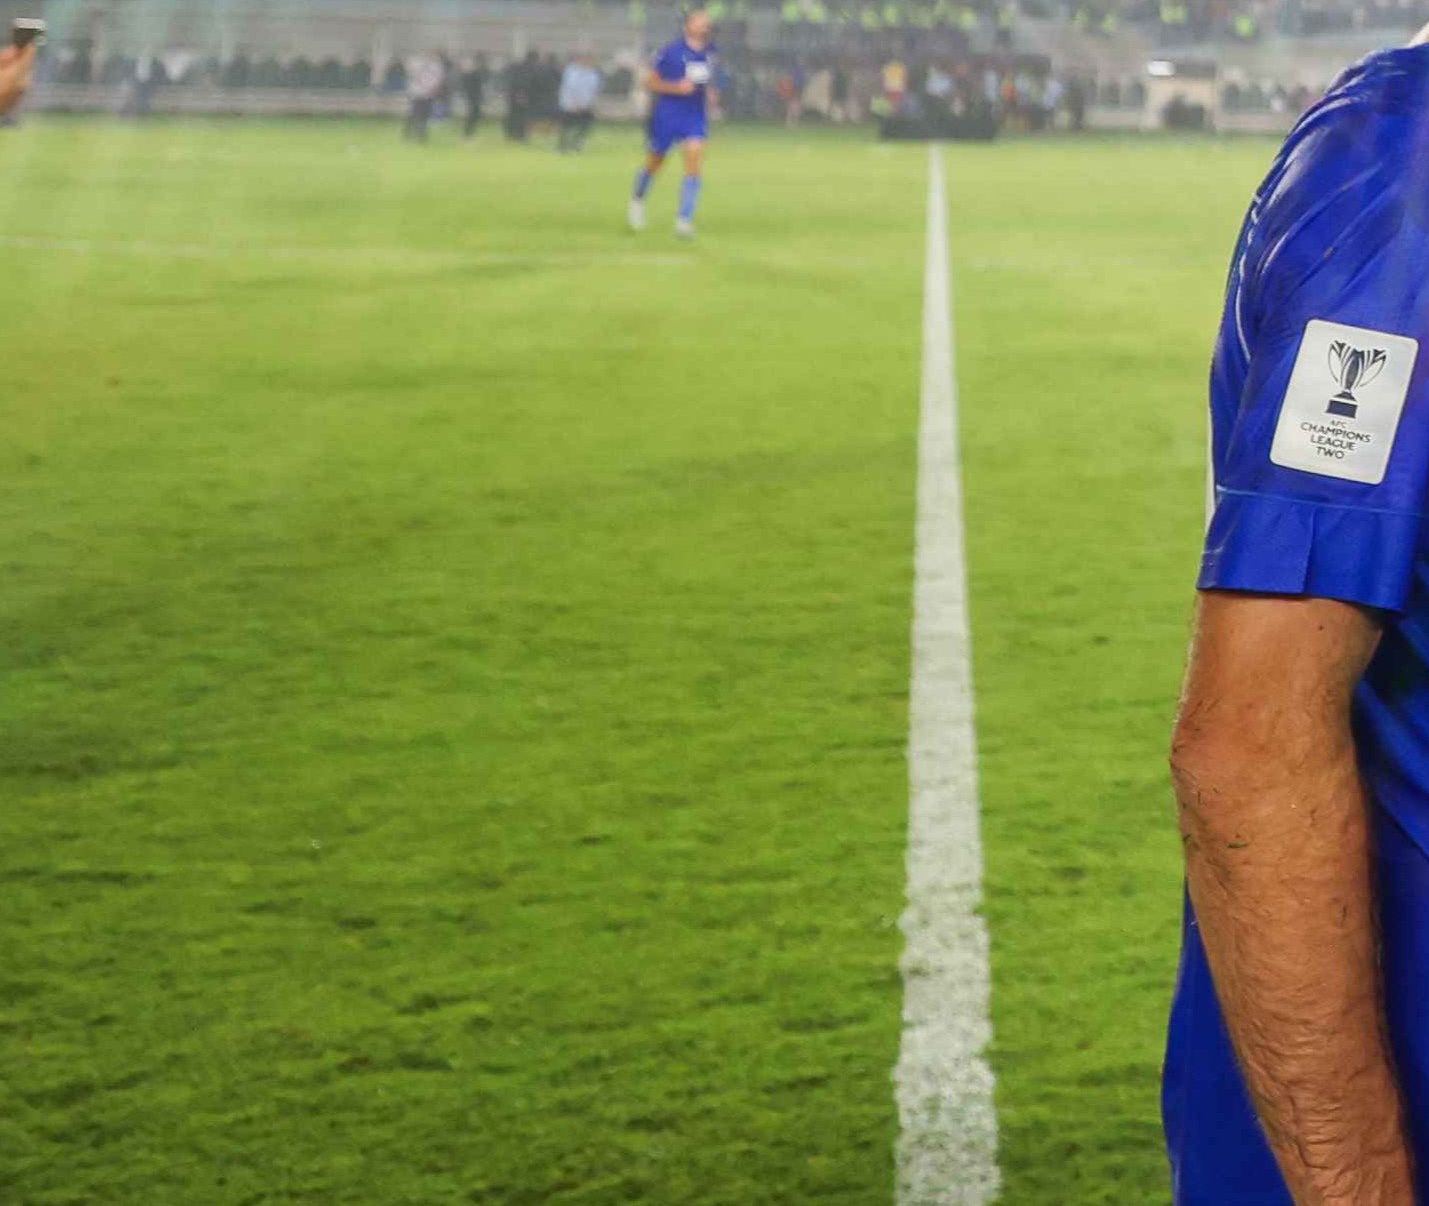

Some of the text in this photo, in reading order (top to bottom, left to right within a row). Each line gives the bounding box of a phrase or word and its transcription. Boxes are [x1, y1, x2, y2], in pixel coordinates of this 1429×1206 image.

[1300, 421, 1372, 443] CHAMPIONS
[1310, 434, 1356, 451] LEAGUE
[1315, 445, 1345, 459] TWO
